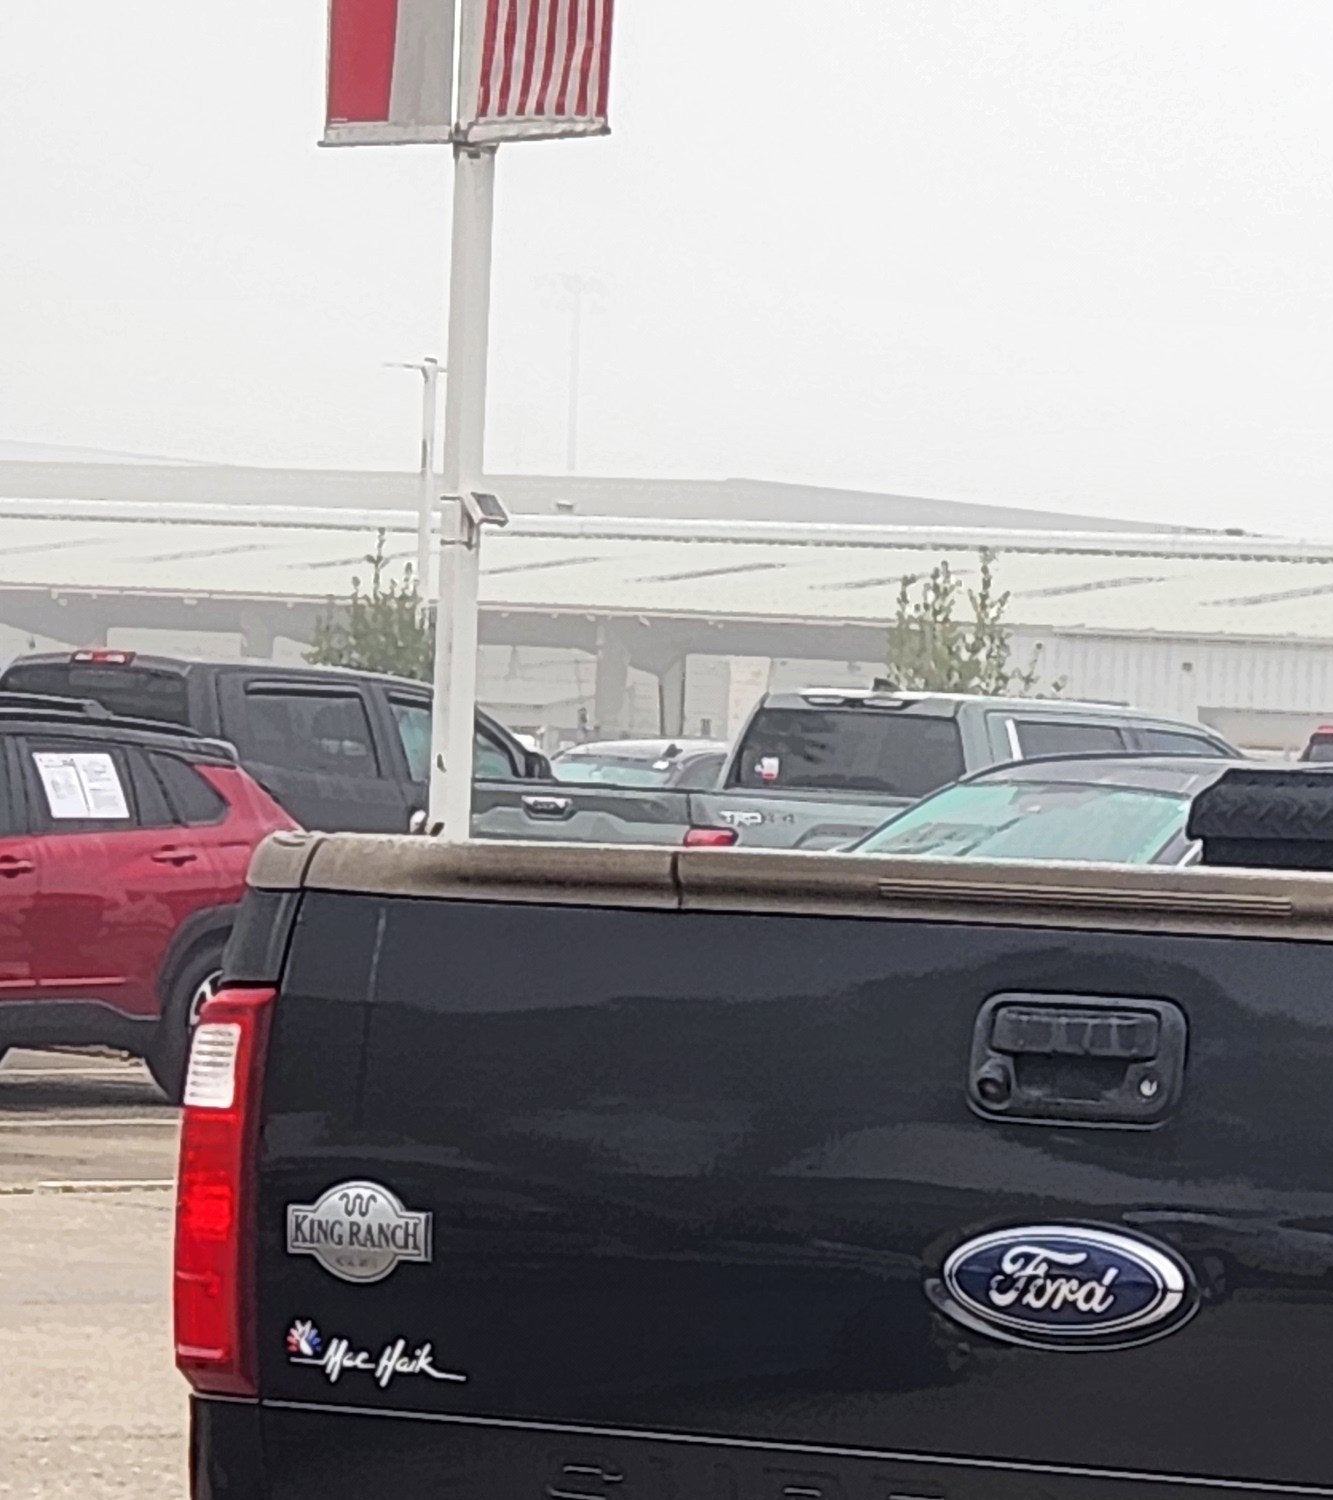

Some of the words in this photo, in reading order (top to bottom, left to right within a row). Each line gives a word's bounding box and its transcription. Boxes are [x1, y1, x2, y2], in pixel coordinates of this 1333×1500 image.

[291, 1214, 344, 1247] KING
[349, 1220, 420, 1251] RANCH
[988, 1245, 1119, 1313] Ford
